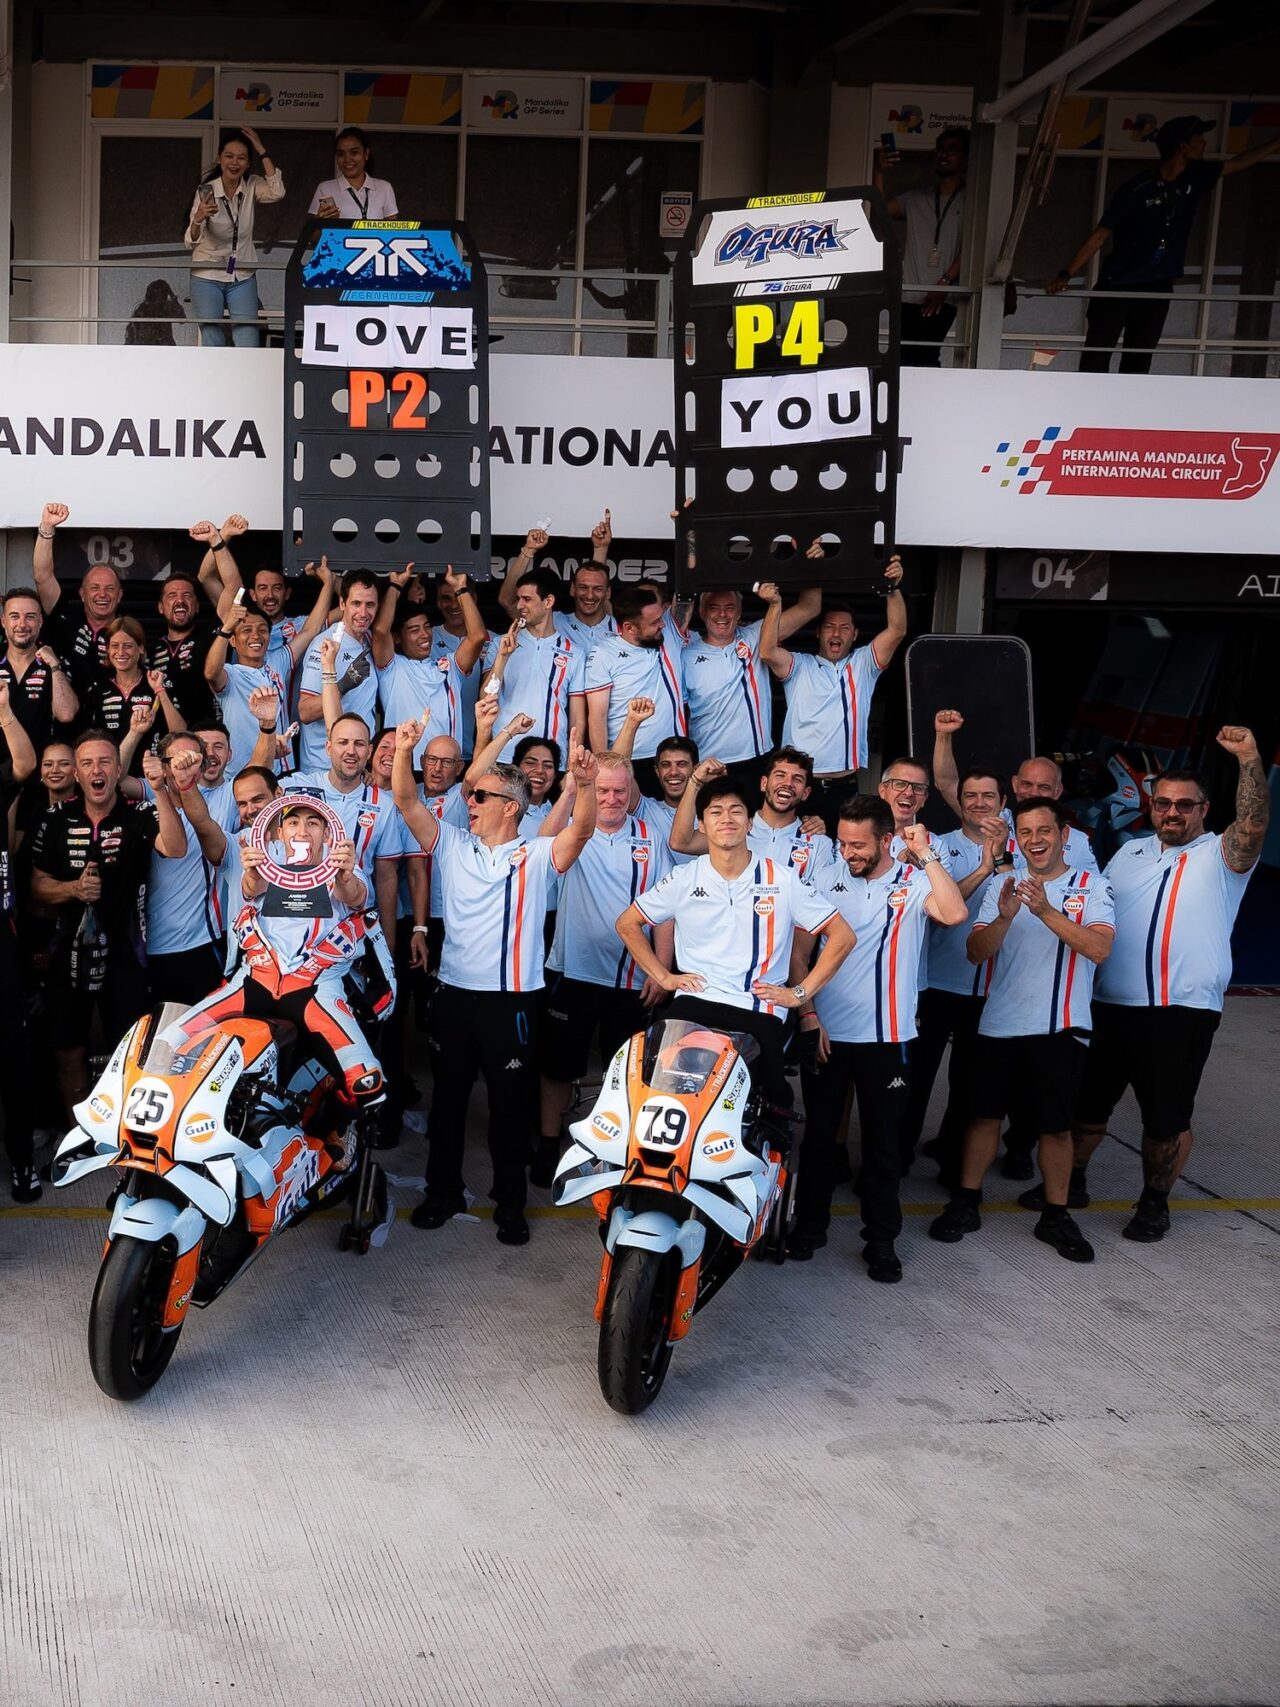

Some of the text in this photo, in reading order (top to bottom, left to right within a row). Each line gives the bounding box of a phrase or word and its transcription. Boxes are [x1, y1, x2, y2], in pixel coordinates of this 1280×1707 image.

[277, 99, 292, 107] GP
[278, 90, 324, 99] Mandalika
[524, 98, 570, 107] Mandalika
[523, 106, 539, 114] GP
[757, 193, 814, 205] TRACKHOUSE
[361, 221, 412, 230] TRACKHOUSE
[716, 219, 852, 268] OGURA
[351, 292, 422, 301] FERNANDEZ
[762, 281, 784, 294] 79
[783, 283, 813, 292] OGURA
[314, 317, 468, 356] LOVE
[734, 300, 824, 370] P4
[349, 370, 429, 429] P2
[729, 391, 862, 433] YOU
[489, 425, 676, 468] ATIONA
[1062, 449, 1227, 465] PERTAMINA MANDALIKA
[1060, 465, 1223, 481] INTERNATIONAL CIRCUIT
[86, 535, 135, 567] 03
[1031, 556, 1076, 590] 04
[89, 1097, 113, 1121] Gulf
[126, 1086, 169, 1126] 25
[184, 1120, 217, 1136] Gulf
[592, 1114, 622, 1138] Gulf
[641, 1105, 688, 1146] 79
[702, 1139, 736, 1157] Gulf
